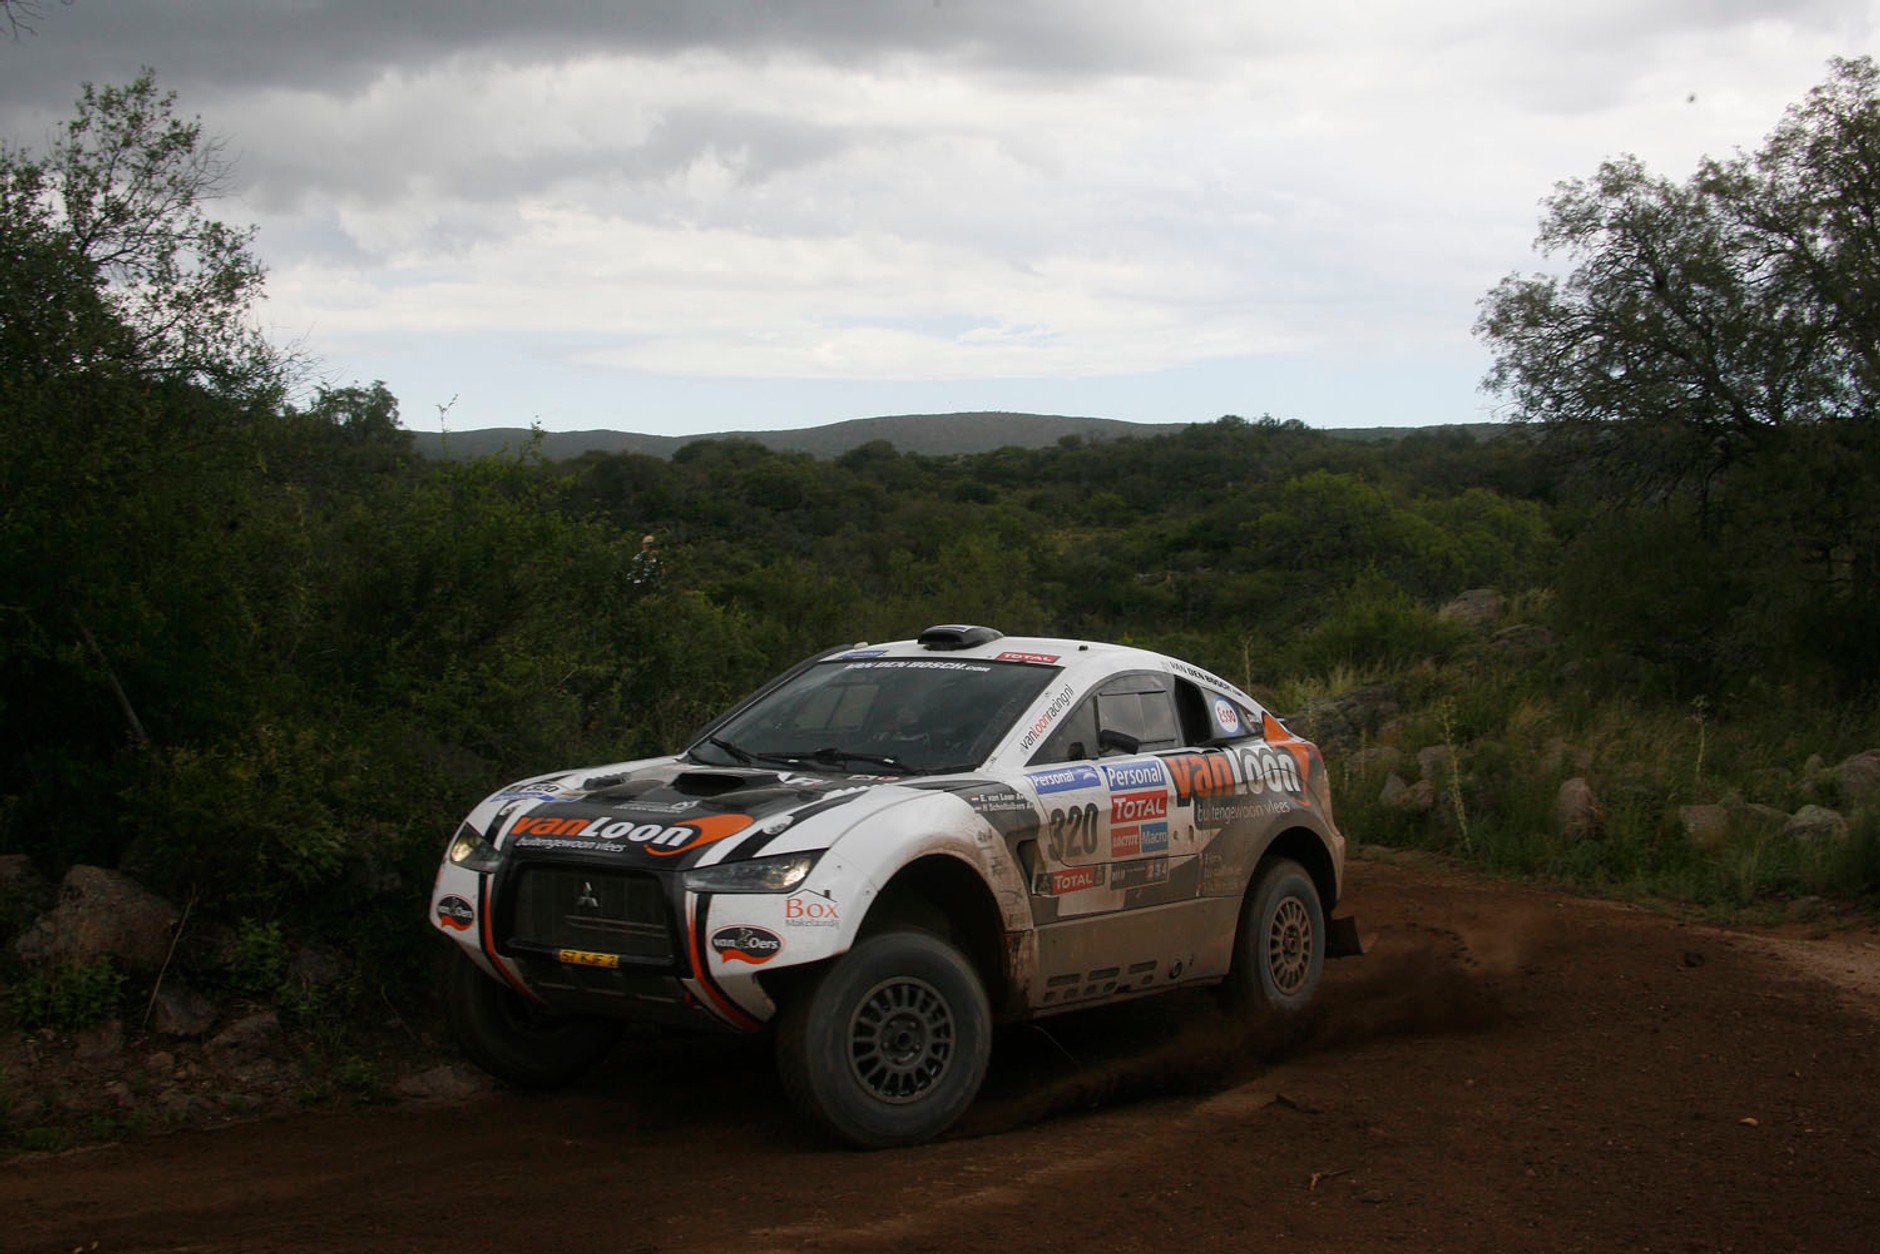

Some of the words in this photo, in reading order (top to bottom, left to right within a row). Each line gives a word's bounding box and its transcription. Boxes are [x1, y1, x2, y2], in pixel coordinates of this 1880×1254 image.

[1001, 652, 1053, 662] TOTAL
[1031, 770, 1075, 787] Personal
[1108, 765, 1161, 788] Personal
[1112, 797, 1165, 819] TOTAL
[1047, 802, 1099, 862] 320
[1054, 874, 1094, 891] TOTAL
[785, 898, 839, 918] Box
[713, 938, 736, 948] van
[749, 937, 779, 950] Oers
